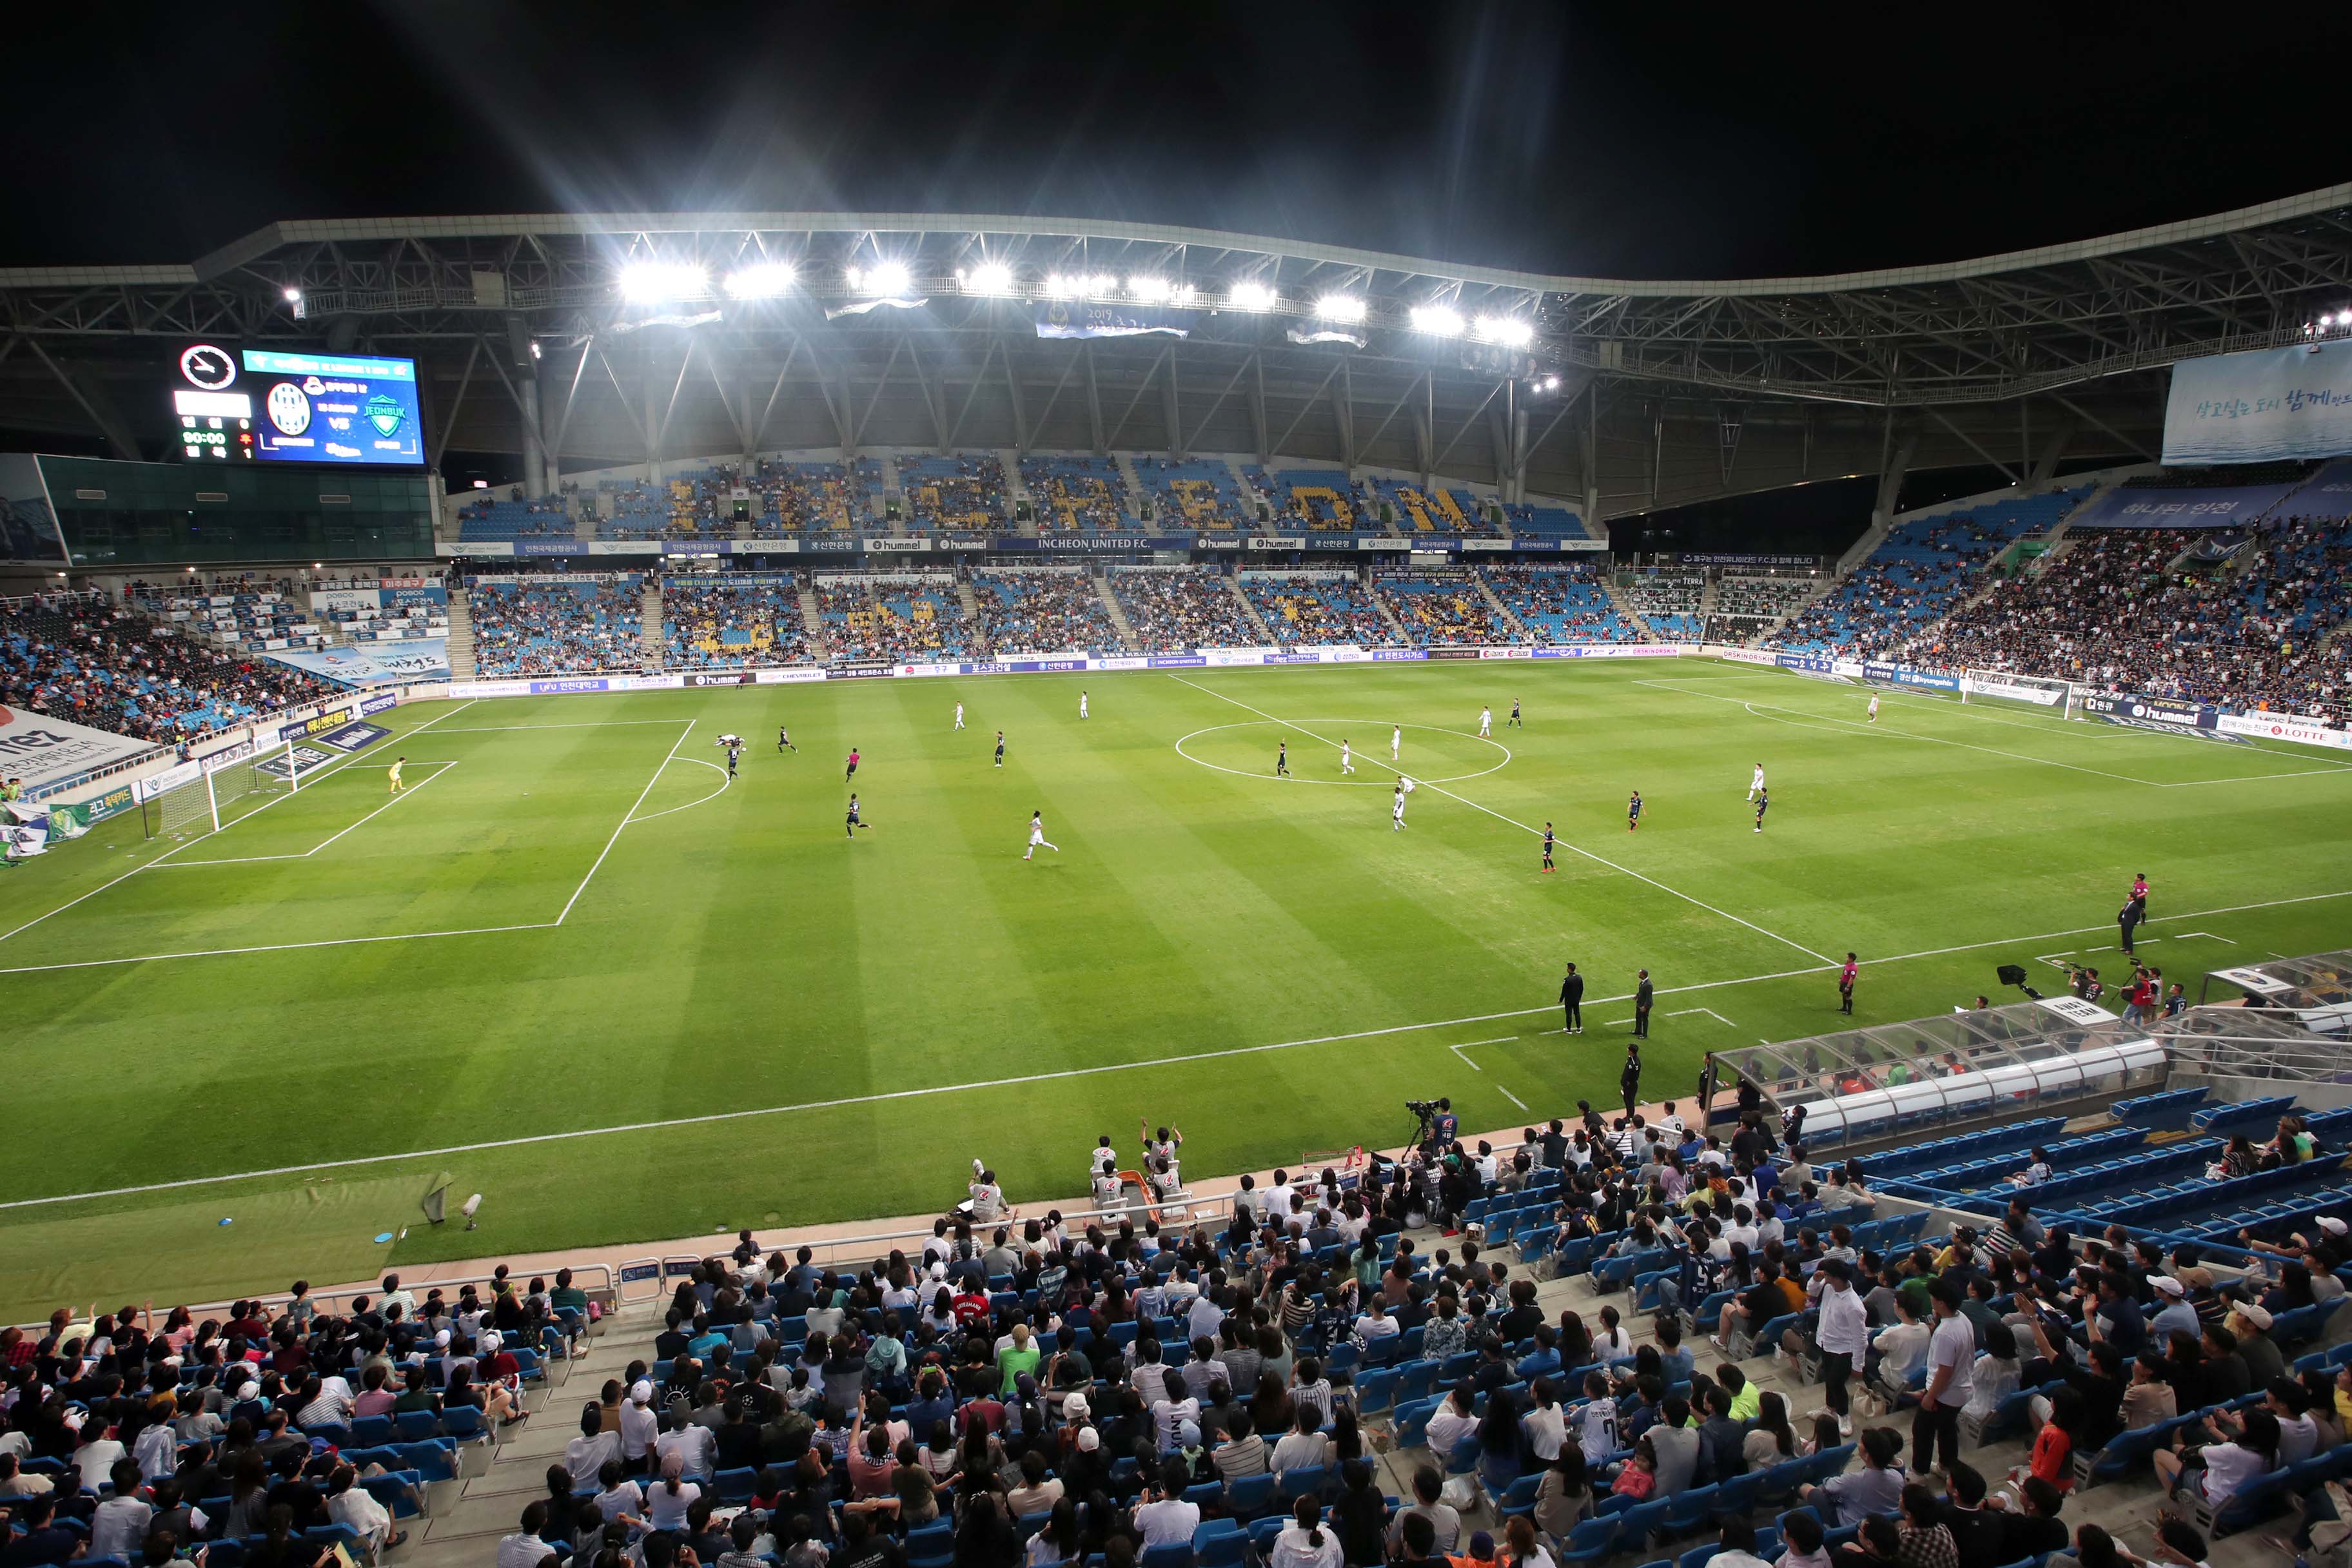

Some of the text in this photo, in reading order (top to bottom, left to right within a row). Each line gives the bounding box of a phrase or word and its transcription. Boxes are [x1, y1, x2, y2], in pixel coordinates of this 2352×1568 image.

[2197, 399, 2251, 418] 살고싶은
[2254, 399, 2280, 413] 도시
[2285, 389, 2331, 413] 함께
[364, 406, 406, 419] JEONBUK
[182, 431, 226, 445] 90:00
[2190, 501, 2239, 514] 인천
[754, 541, 787, 550] 신한은행
[820, 541, 852, 549] 신한은행
[884, 540, 920, 550] hummel
[951, 540, 986, 549] hummel
[1039, 539, 1150, 549] INCHEON UNITED F.C.
[1208, 539, 1240, 548] hummel
[1266, 540, 1297, 548] hummel
[1683, 576, 1703, 585] TERRA
[1385, 651, 1424, 660] 인천도시가스
[1724, 651, 1775, 663] DRSKIN DRSKIN
[972, 663, 1011, 672] 포스코건설
[707, 675, 740, 684] humme
[1871, 670, 1892, 678] 신한은행
[560, 680, 600, 691] 인천대학교
[1919, 676, 1954, 687] kyungshin
[2146, 707, 2198, 725] hummel
[2238, 721, 2253, 730] 가는
[2253, 723, 2269, 732] 친구
[288, 726, 306, 739] 신한은행
[2285, 728, 2328, 741] LOTTE
[104, 789, 132, 808] 축덕카드
[2053, 1001, 2086, 1012] AWAY
[2066, 1007, 2101, 1019] TEAM
